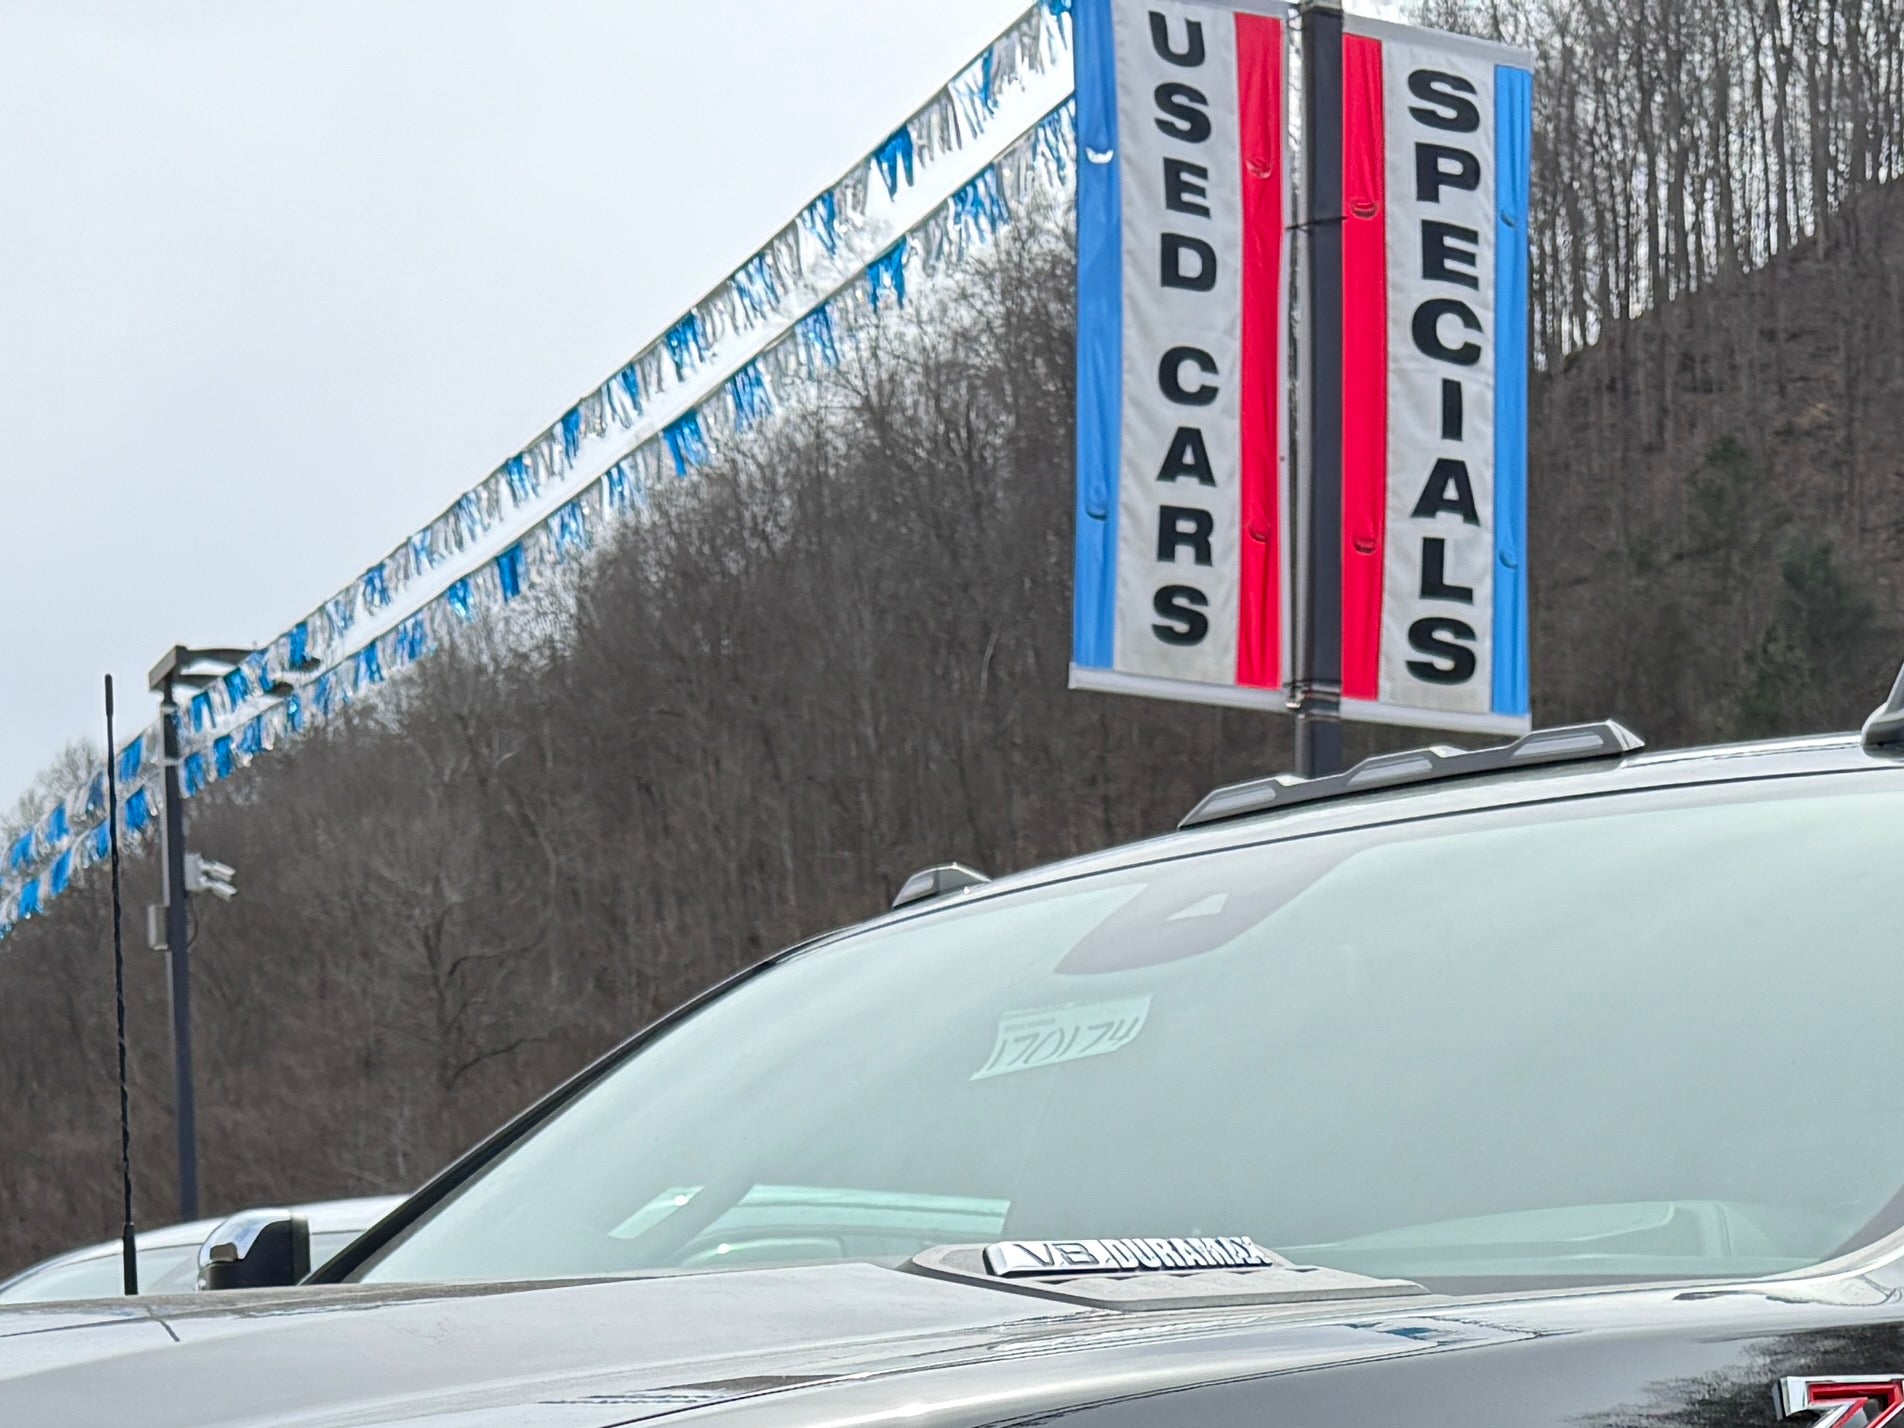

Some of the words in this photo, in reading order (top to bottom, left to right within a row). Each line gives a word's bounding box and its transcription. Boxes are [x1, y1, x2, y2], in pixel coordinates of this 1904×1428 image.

[1149, 10, 1218, 292] USED
[1152, 346, 1220, 646] CARS
[1406, 68, 1485, 686] SPECIALS
[1013, 1242, 1099, 1267] V8
[1098, 1236, 1273, 1270] DURAMAX
